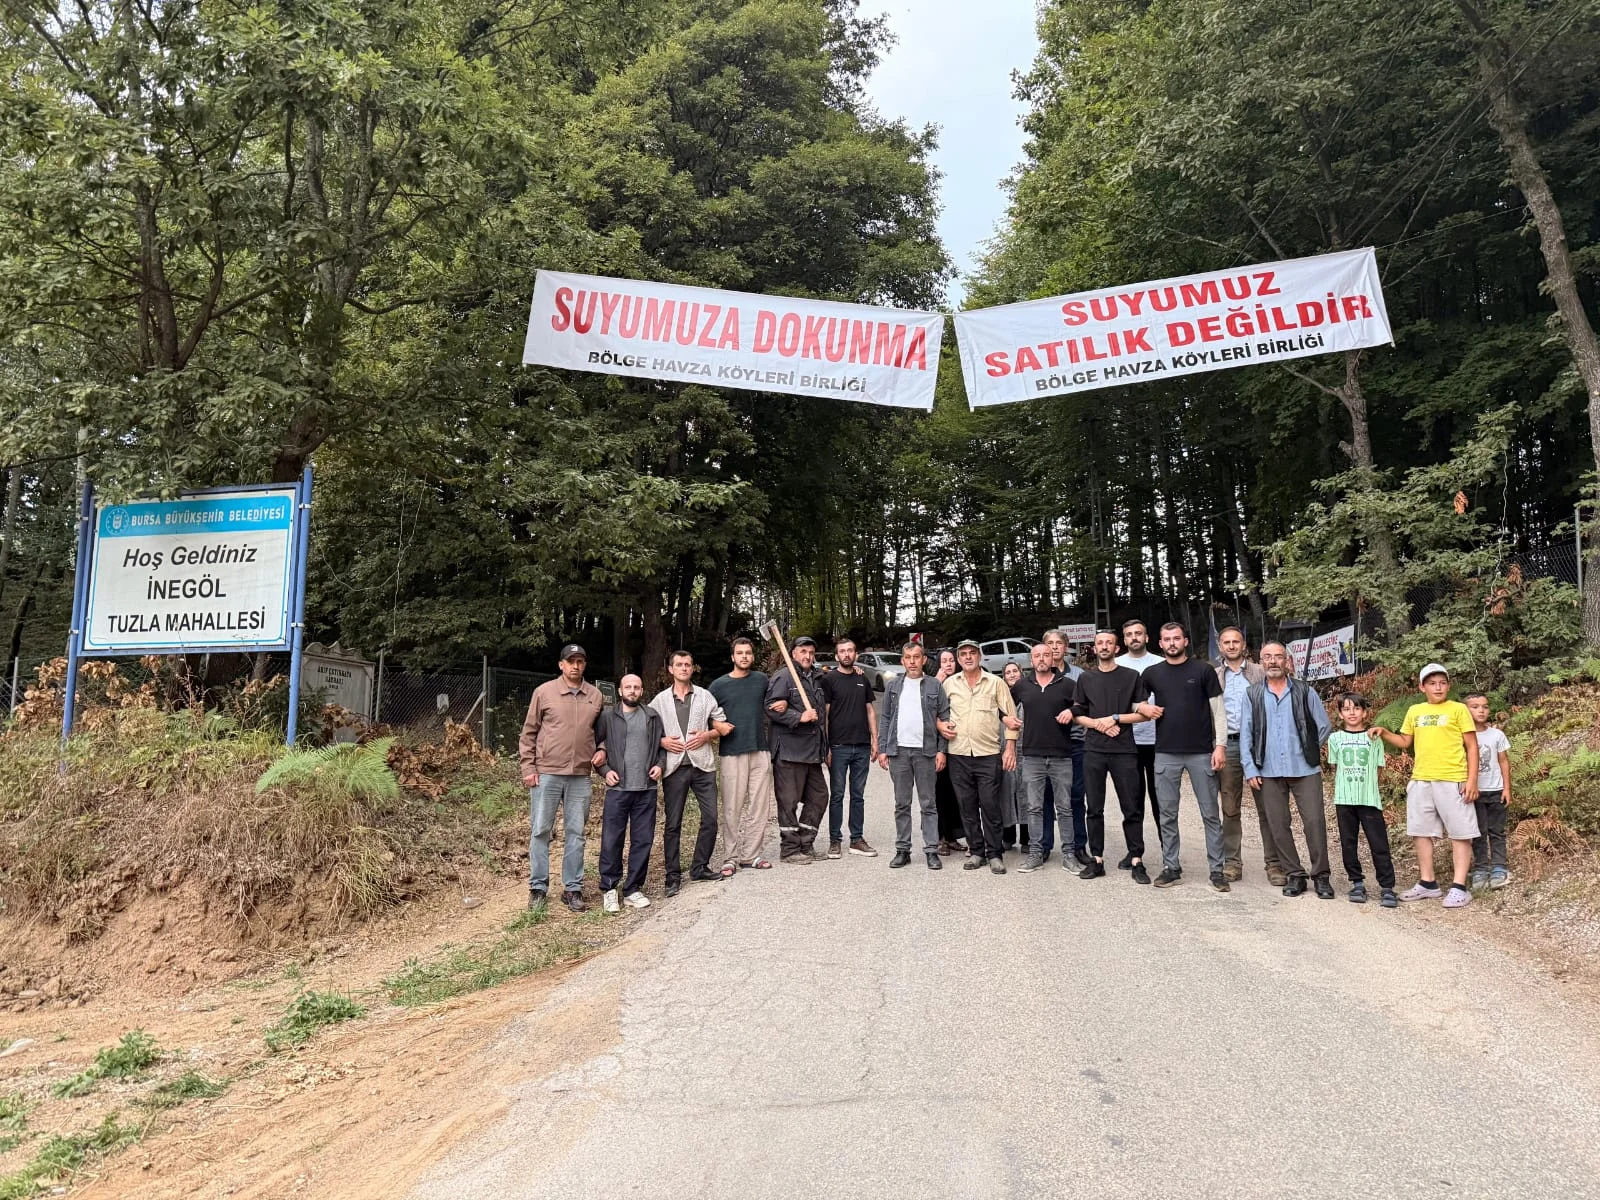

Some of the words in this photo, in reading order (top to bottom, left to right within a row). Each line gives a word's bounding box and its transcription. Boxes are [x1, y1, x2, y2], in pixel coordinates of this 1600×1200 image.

[1061, 271, 1281, 326] SUYUMUZ
[551, 286, 740, 351] SUYUMUZA
[753, 310, 927, 371] DOKUNMA
[984, 326, 1154, 378] SATILIK
[1166, 290, 1373, 348] DEĞİLDİR
[587, 350, 648, 369] BÖLGE
[652, 358, 713, 378] HAVZA
[717, 364, 795, 386] KÖYLERİ
[800, 374, 868, 394] BİRLİĞİ
[1035, 369, 1099, 392] BÖLGE
[1103, 360, 1167, 380] HAVZA
[1171, 342, 1252, 370] KÖYLERİ
[1256, 331, 1326, 360] BİRLİĞİ
[131, 512, 161, 526] BURSA
[165, 508, 224, 525] BÜYÜKŞEHİR
[229, 505, 285, 522] BELEDİYESİ
[123, 548, 164, 571] Hoş
[170, 544, 258, 565] Geldiniz
[147, 574, 227, 600] İNEGÖL
[108, 614, 160, 633] TUZLA
[165, 606, 266, 632] MAHALLESİ
[1342, 747, 1369, 766] 09
